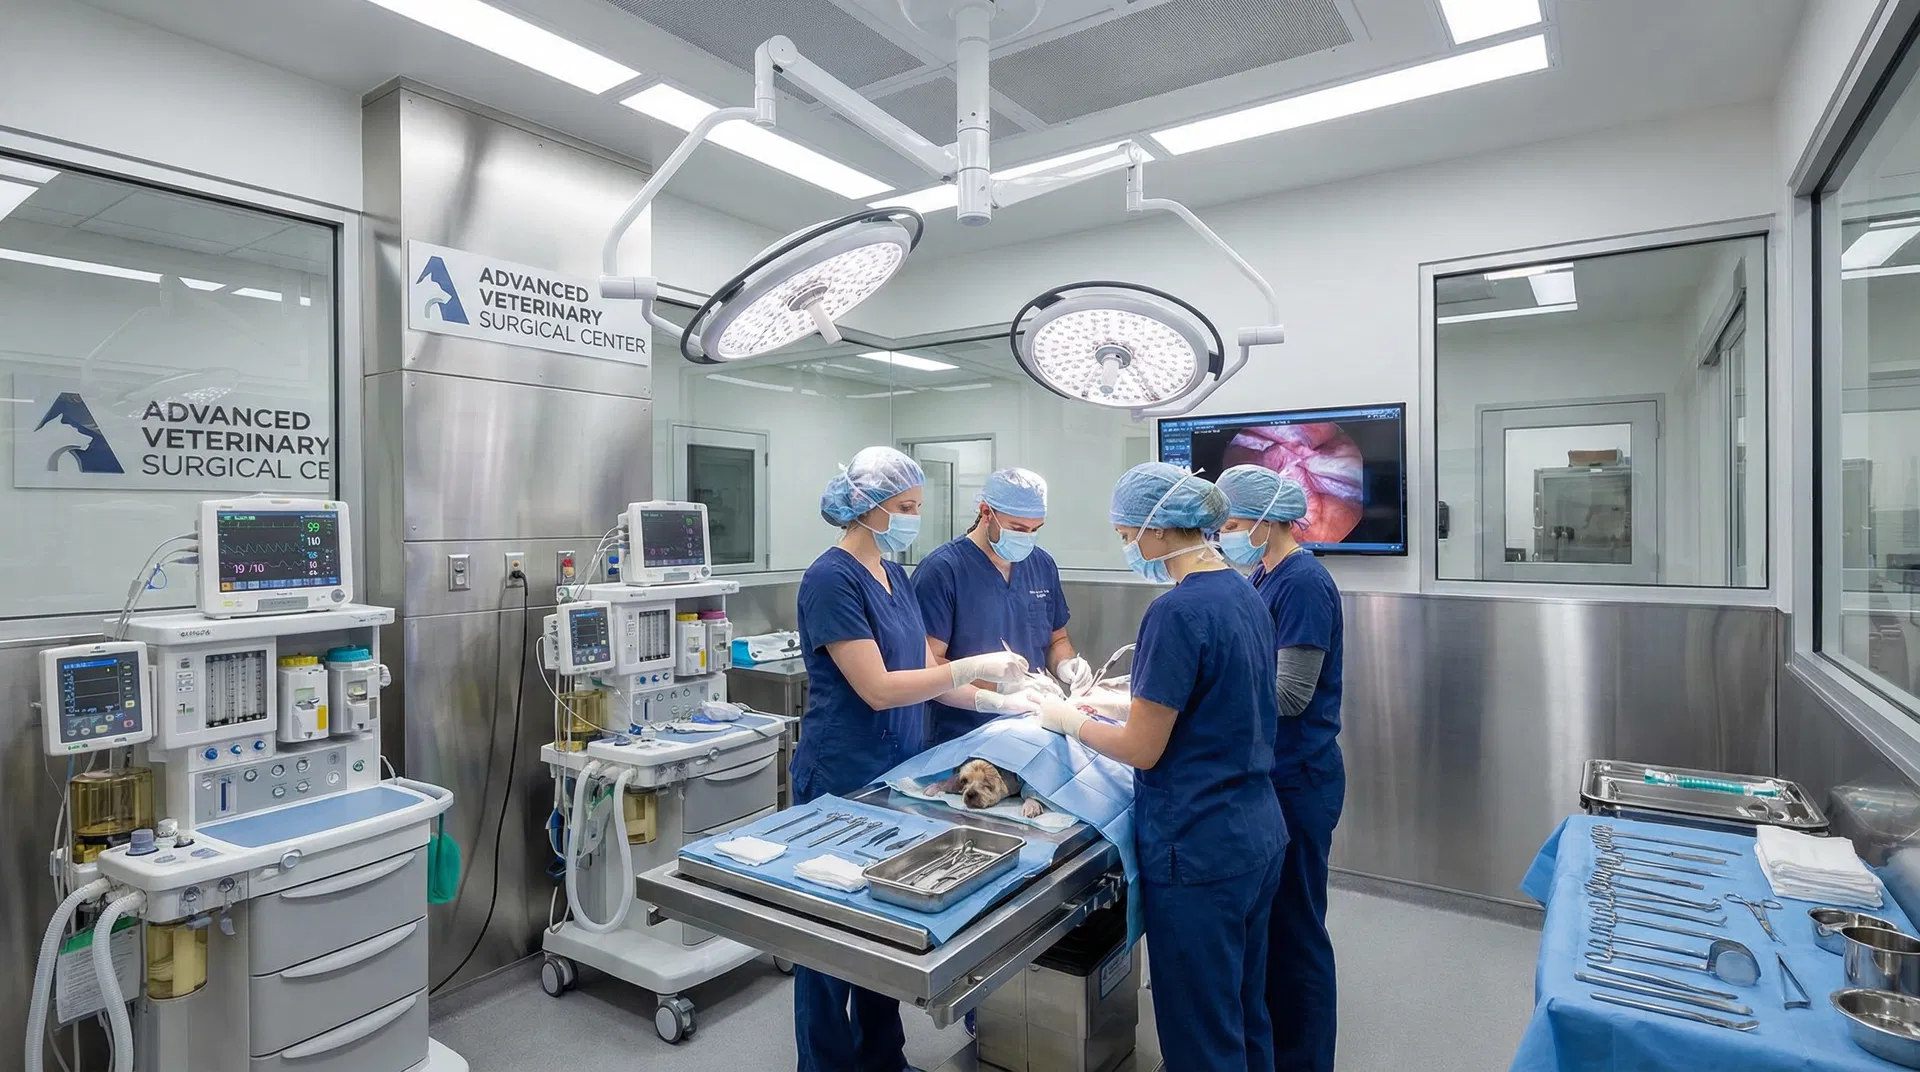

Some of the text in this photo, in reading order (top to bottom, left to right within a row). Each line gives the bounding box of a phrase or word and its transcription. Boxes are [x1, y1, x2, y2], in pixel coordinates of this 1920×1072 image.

[479, 267, 589, 303] ADVANCED
[479, 288, 603, 326] VETERINARY
[479, 311, 646, 354] SURGICAL CENTER
[141, 400, 311, 431] ADVANCED
[141, 427, 329, 456] VETERINARY
[142, 454, 292, 479] SURGICAL
